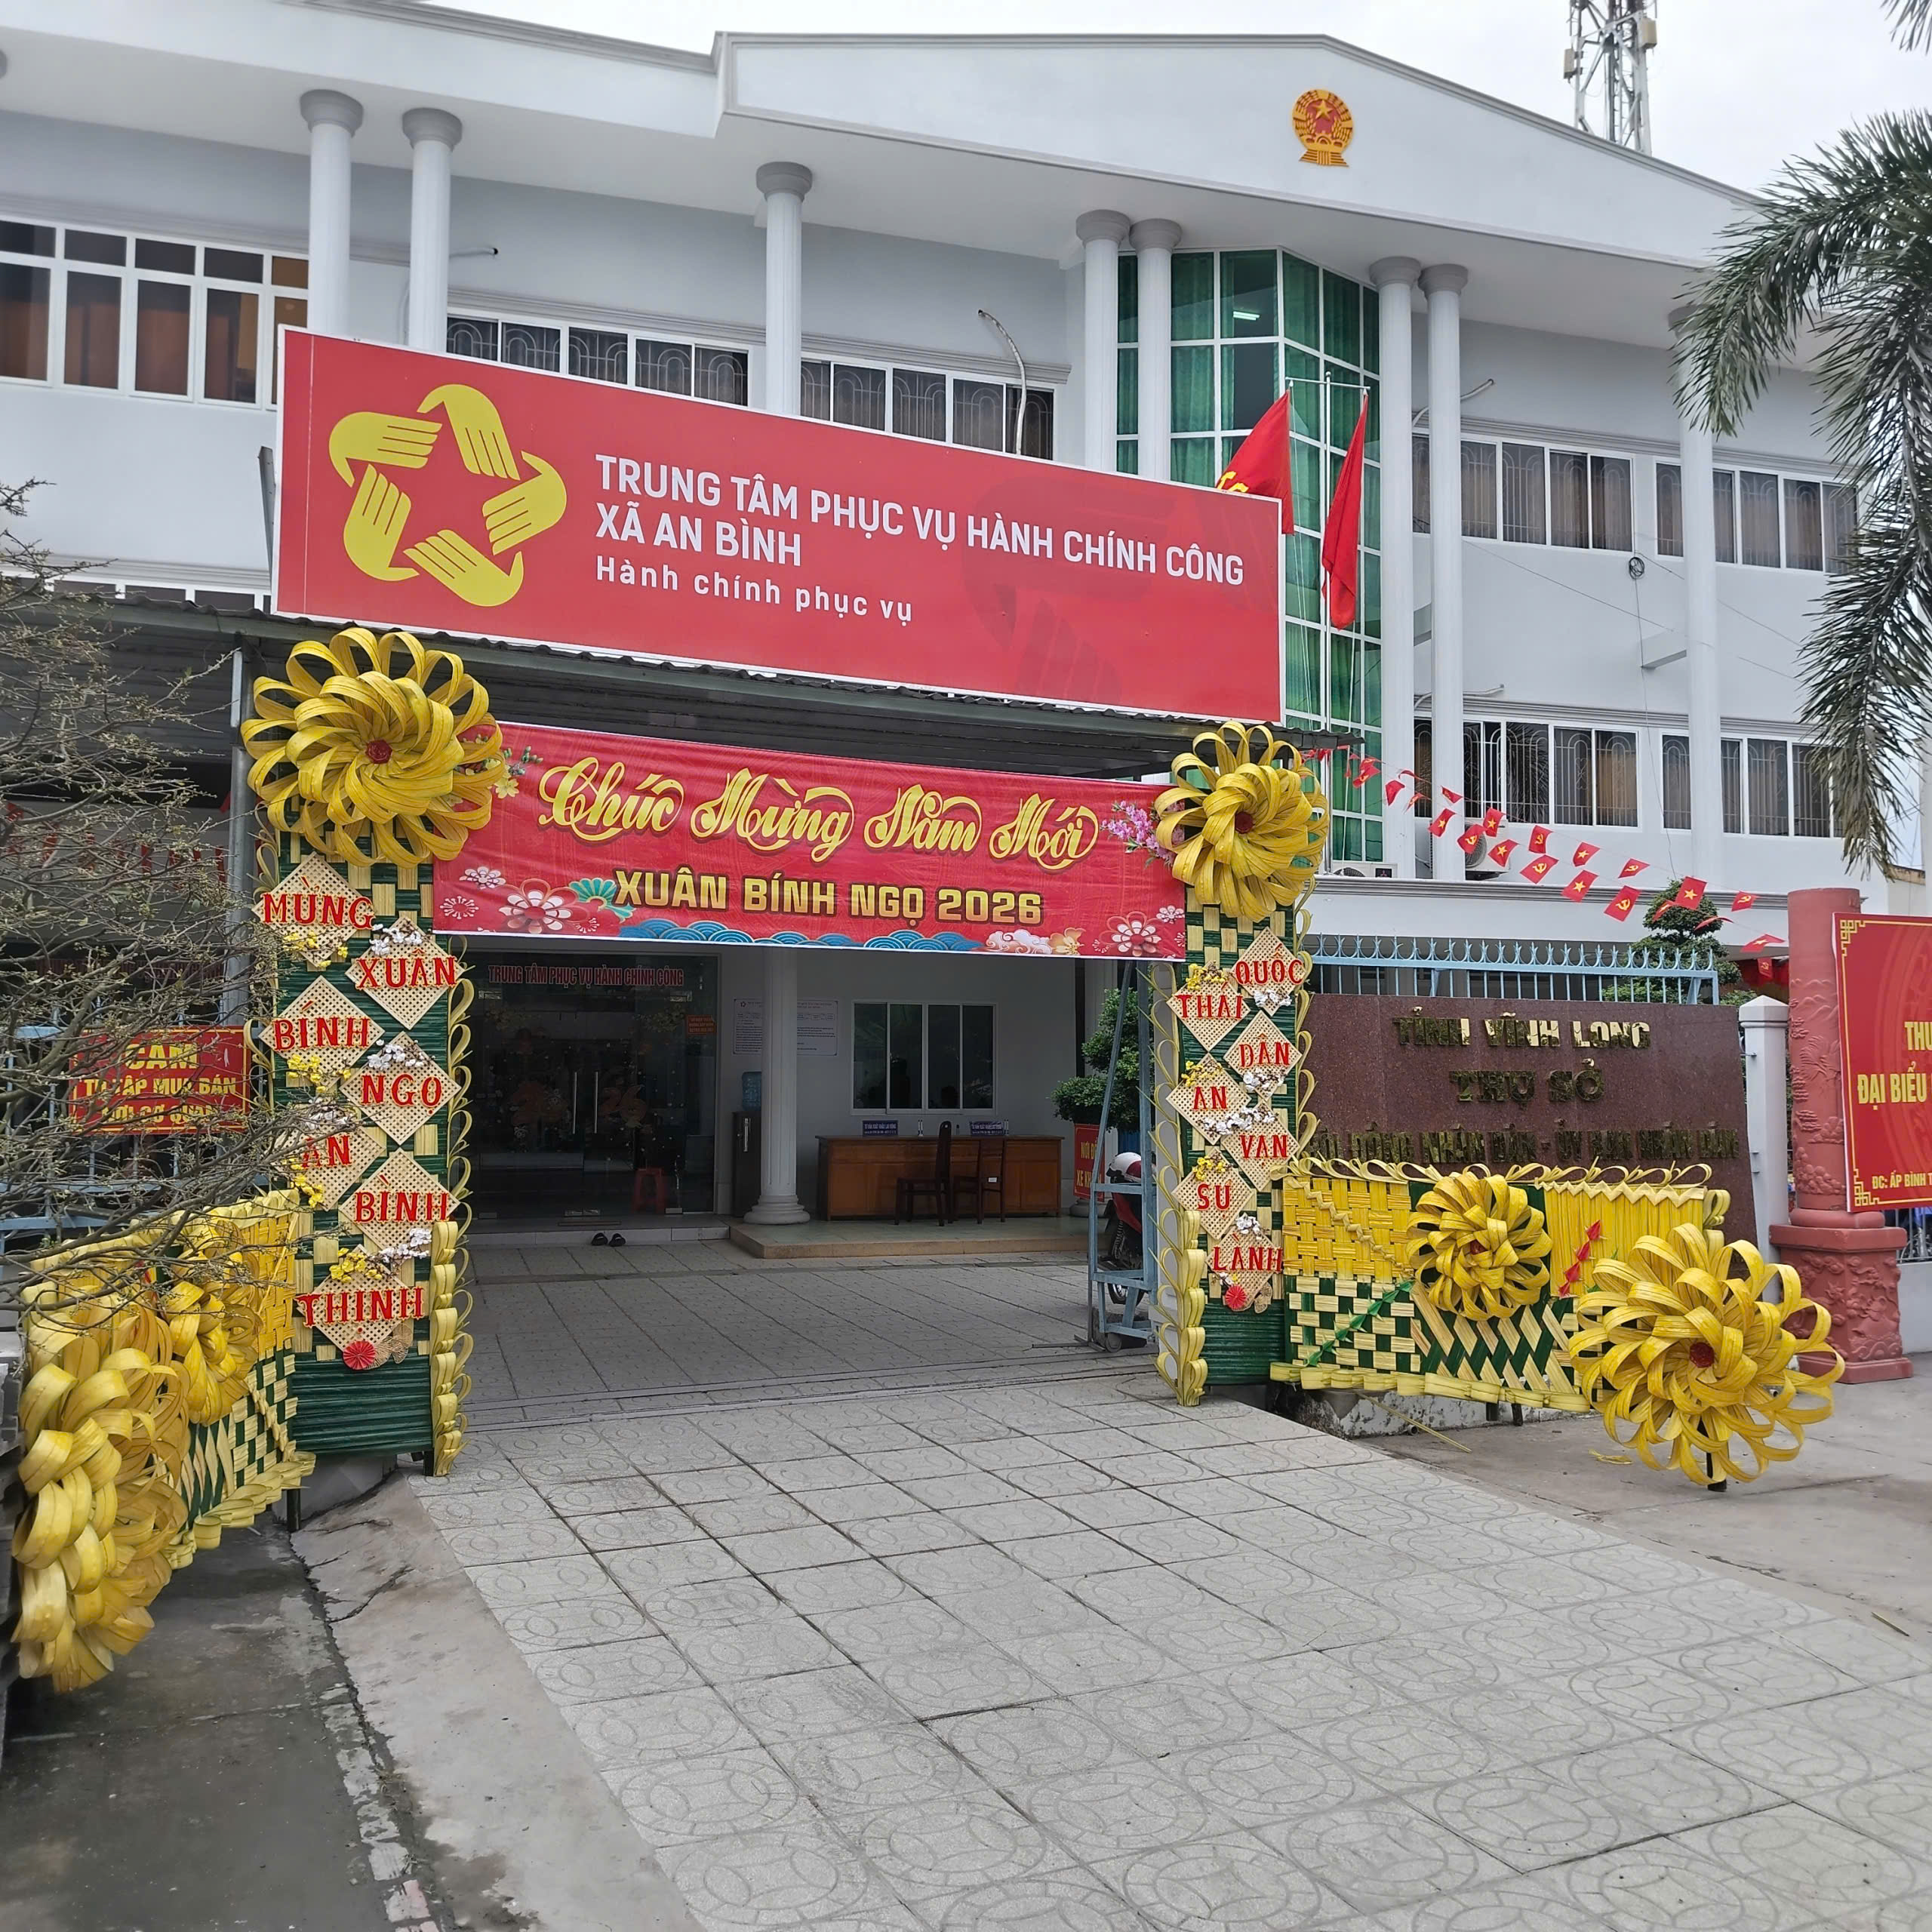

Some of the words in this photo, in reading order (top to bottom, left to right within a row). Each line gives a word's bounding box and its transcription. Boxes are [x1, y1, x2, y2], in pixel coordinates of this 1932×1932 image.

[595, 454, 721, 506] TRUNG
[730, 473, 798, 519] TÂM
[811, 489, 904, 540] PHỤC
[912, 505, 956, 551] VỤ
[967, 512, 1054, 558] HÀNH
[1063, 530, 1157, 574] CHÍNH
[1165, 543, 1244, 586] CÔNG
[595, 500, 646, 544] XÃ
[653, 512, 703, 552] AN
[715, 518, 801, 567] BÌNH
[596, 555, 678, 591] Hành
[693, 571, 781, 605] chính
[795, 585, 868, 619] phục
[879, 599, 912, 627] vụ
[538, 756, 685, 842] Chúc
[690, 767, 855, 863] Mừng
[989, 792, 1100, 870] Mới
[262, 875, 376, 931] MỪNG
[614, 868, 729, 910] XUÂN
[743, 872, 835, 915] BÍNH
[850, 883, 924, 927] NGỌ
[937, 889, 1042, 925] 2026
[355, 948, 458, 990] XUÂN
[488, 965, 523, 984] TRUNG
[525, 963, 548, 985] TÂM
[549, 966, 578, 989] PHỤC
[579, 967, 593, 989] VỤ
[594, 964, 623, 986] HÀNH
[623, 965, 655, 986] CHÍNH
[656, 965, 685, 986] CÔNG
[1235, 943, 1304, 986] QUỐC
[1175, 981, 1244, 1020] THÁI
[272, 1000, 371, 1051] BÍNH
[1484, 1011, 1561, 1048] VĨNH
[1570, 1020, 1652, 1049] LONG
[1238, 1033, 1291, 1068] DÂN
[199, 1075, 237, 1094] BÁN
[361, 1073, 443, 1115] NGỌ
[1192, 1085, 1228, 1111] AN
[1857, 1073, 1886, 1110] ĐẠI
[1889, 1060, 1927, 1103] BIỂU
[1239, 1134, 1289, 1168] VẠN
[354, 1174, 451, 1223] BÌNH
[1196, 1178, 1232, 1219] SỰ
[1890, 1169, 1902, 1189] ẤP
[1904, 1171, 1926, 1187] BÌNH
[1212, 1232, 1284, 1273] LÀNH
[294, 1287, 425, 1335] THỊNH
